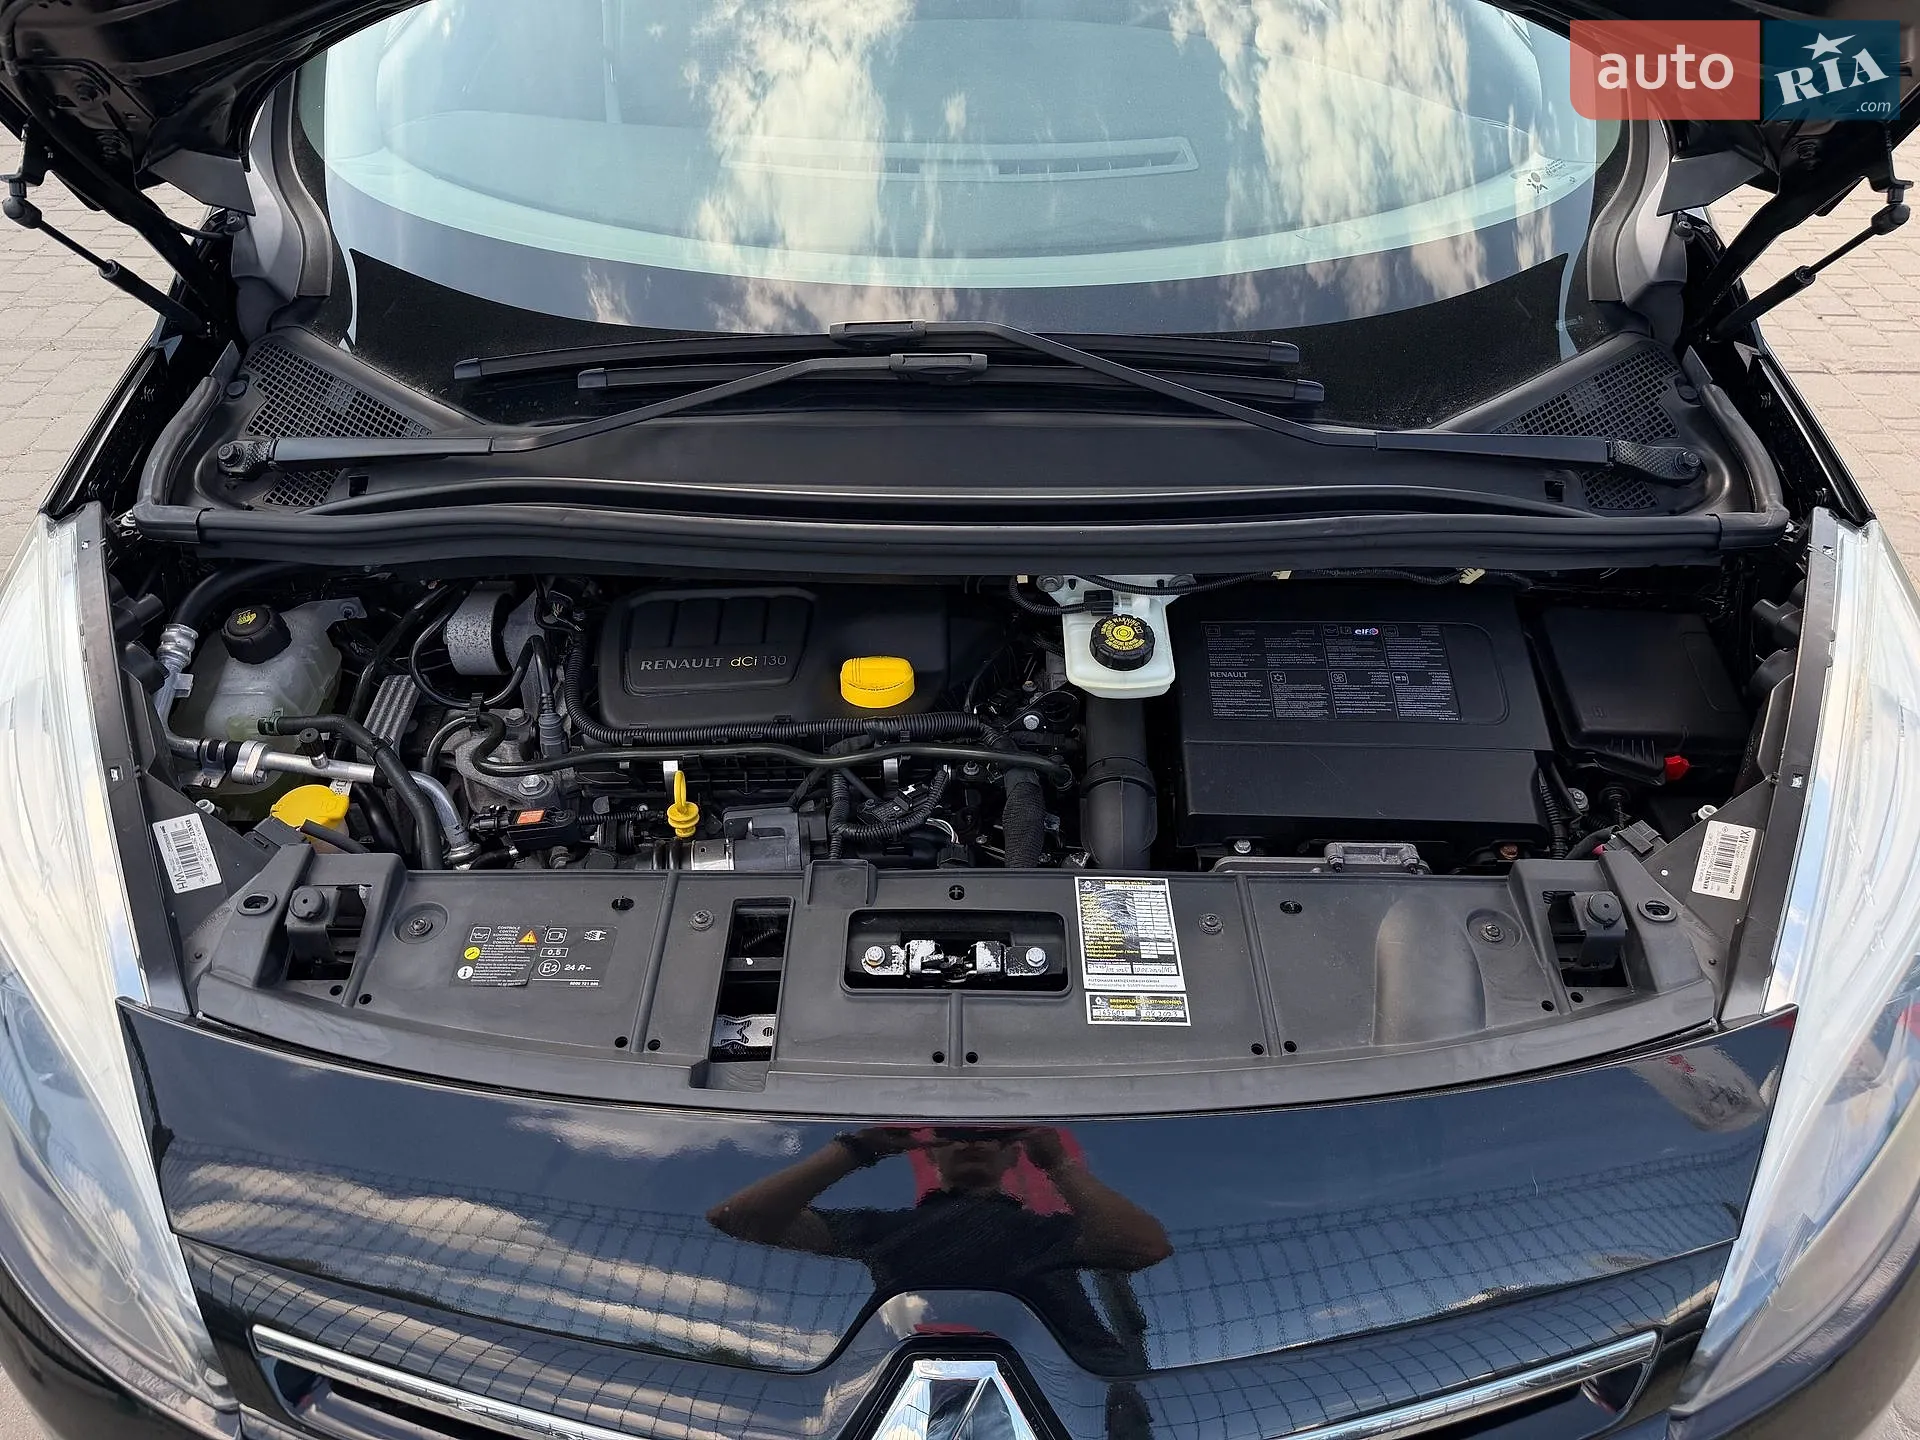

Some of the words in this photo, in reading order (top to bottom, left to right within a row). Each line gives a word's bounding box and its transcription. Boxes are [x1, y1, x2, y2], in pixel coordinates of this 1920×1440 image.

[640, 657, 724, 671] RENAULT
[730, 655, 758, 668] dCi
[762, 655, 787, 667] 130
